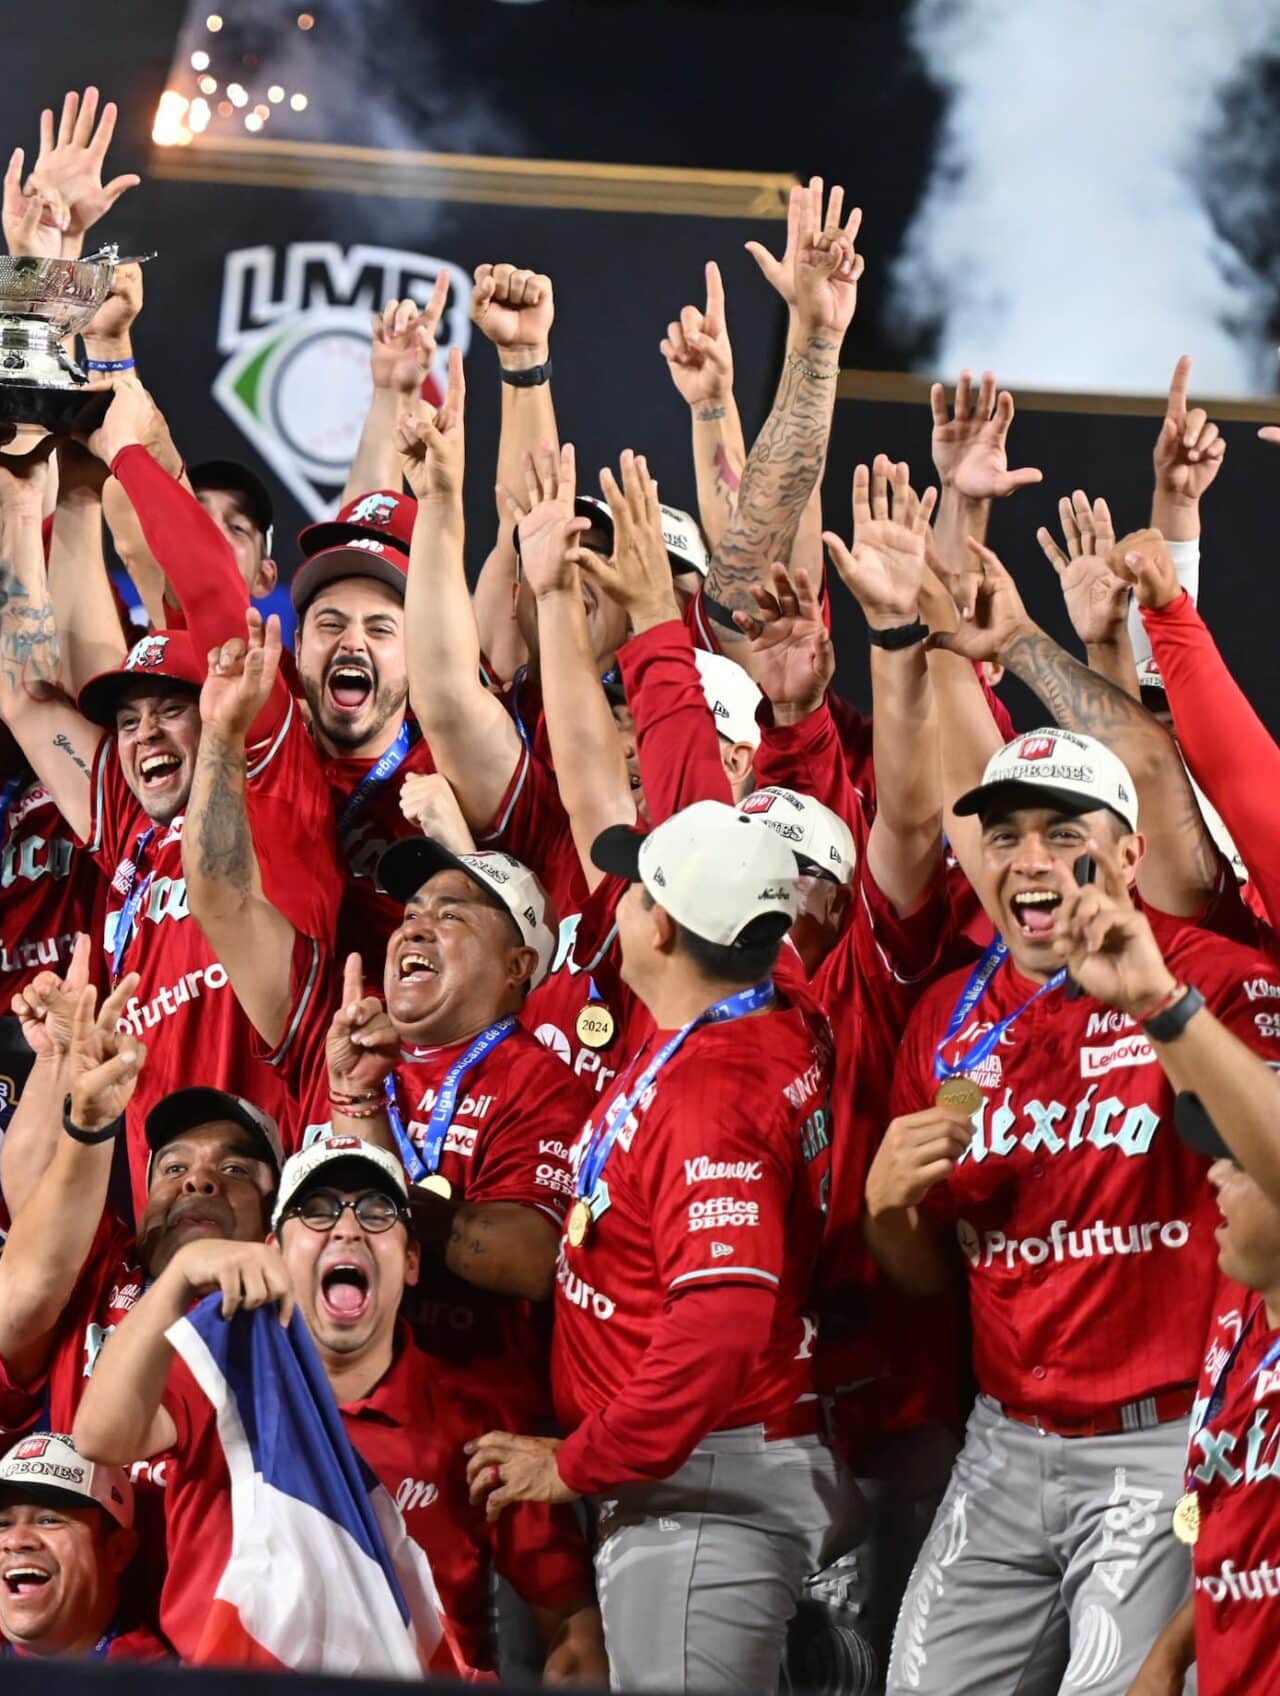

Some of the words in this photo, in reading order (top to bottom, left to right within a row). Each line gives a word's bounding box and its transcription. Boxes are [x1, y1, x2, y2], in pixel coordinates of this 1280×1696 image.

[218, 243, 472, 355] LMB
[375, 751, 401, 777] Liga
[581, 1019, 608, 1033] 2024
[1087, 1043, 1152, 1070] Lenovo
[432, 1090, 452, 1121] Liga
[443, 1041, 488, 1087] Mexicana
[684, 1155, 764, 1186] Kleenex
[688, 1198, 759, 1219] Office
[688, 1213, 760, 1232] DEPOT
[984, 1219, 1190, 1268] Profuturo
